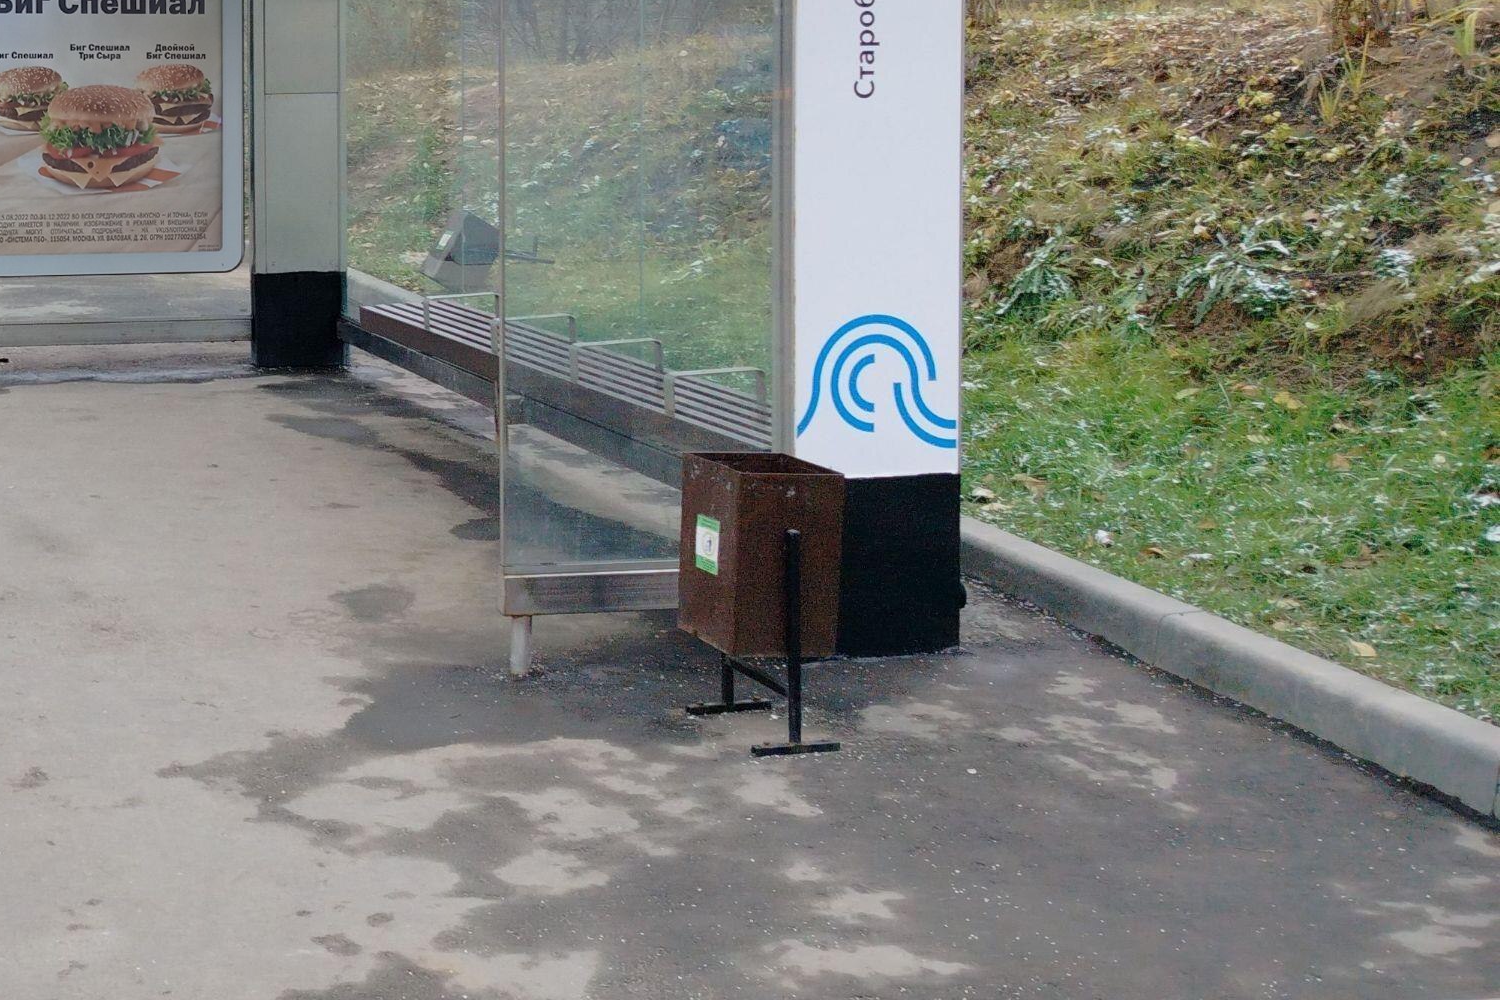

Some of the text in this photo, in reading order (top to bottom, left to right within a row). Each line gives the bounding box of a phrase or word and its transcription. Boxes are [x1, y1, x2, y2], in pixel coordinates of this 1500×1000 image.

[69, 43, 130, 52] Биг Спешиал
[155, 43, 195, 52] Двойной
[11, 52, 54, 60] Спешиал
[78, 52, 121, 61] Три Сыра
[146, 51, 206, 60] Биг Спешиал
